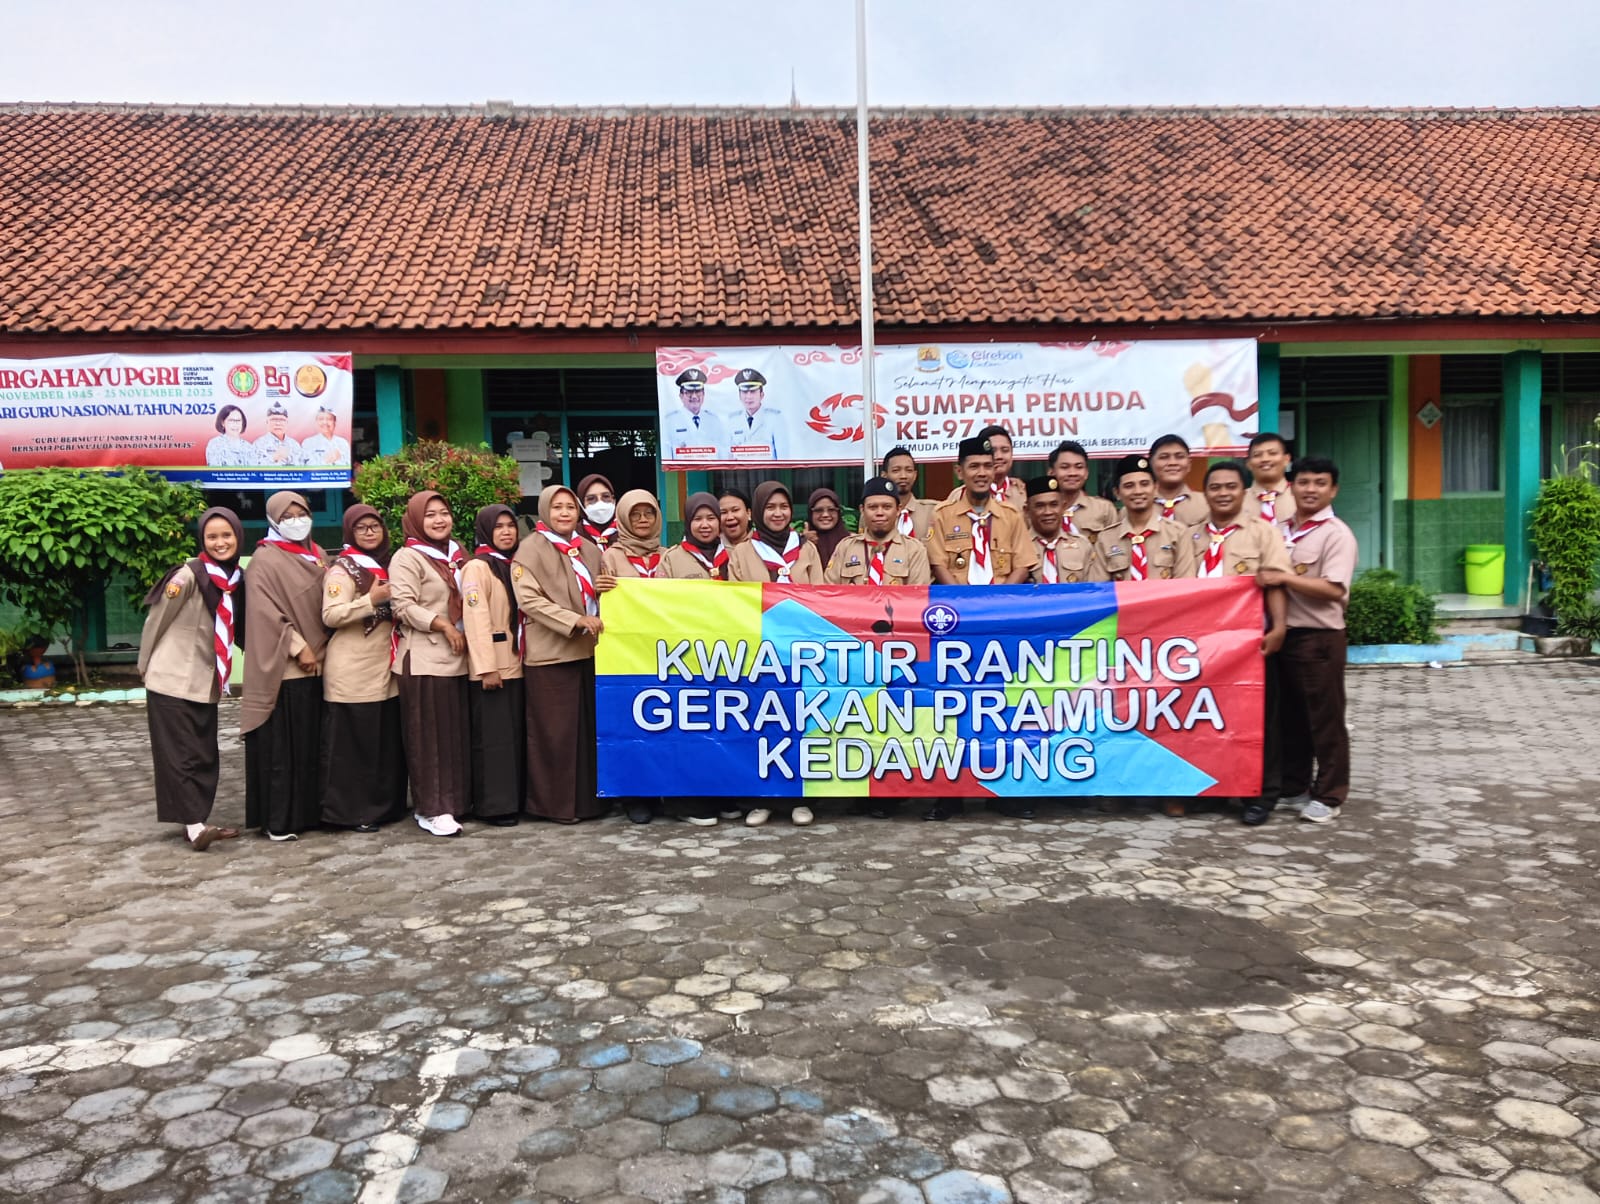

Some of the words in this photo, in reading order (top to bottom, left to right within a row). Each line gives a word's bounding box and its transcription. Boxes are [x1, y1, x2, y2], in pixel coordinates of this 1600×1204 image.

[123, 366, 180, 386] PGRI
[67, 389, 94, 399] 1945
[119, 388, 182, 398] NOVEMBER
[186, 388, 213, 397] 2025
[895, 393, 1014, 416] SUMPAH
[1026, 391, 1145, 413] PEMUDA
[0, 407, 17, 418] RI
[18, 406, 60, 418] GURU
[60, 404, 134, 417] NASIONAL
[134, 404, 183, 415] TAHUN
[185, 403, 216, 415] 2025
[896, 419, 974, 440] KE-97
[1101, 438, 1147, 447] BERSATU
[656, 639, 918, 684] KWARTIR
[935, 637, 1201, 683] RANTING
[632, 688, 914, 733] GERAKAN
[933, 687, 1225, 733] PRAMUKA
[758, 736, 1096, 781] KEDAWUNG
